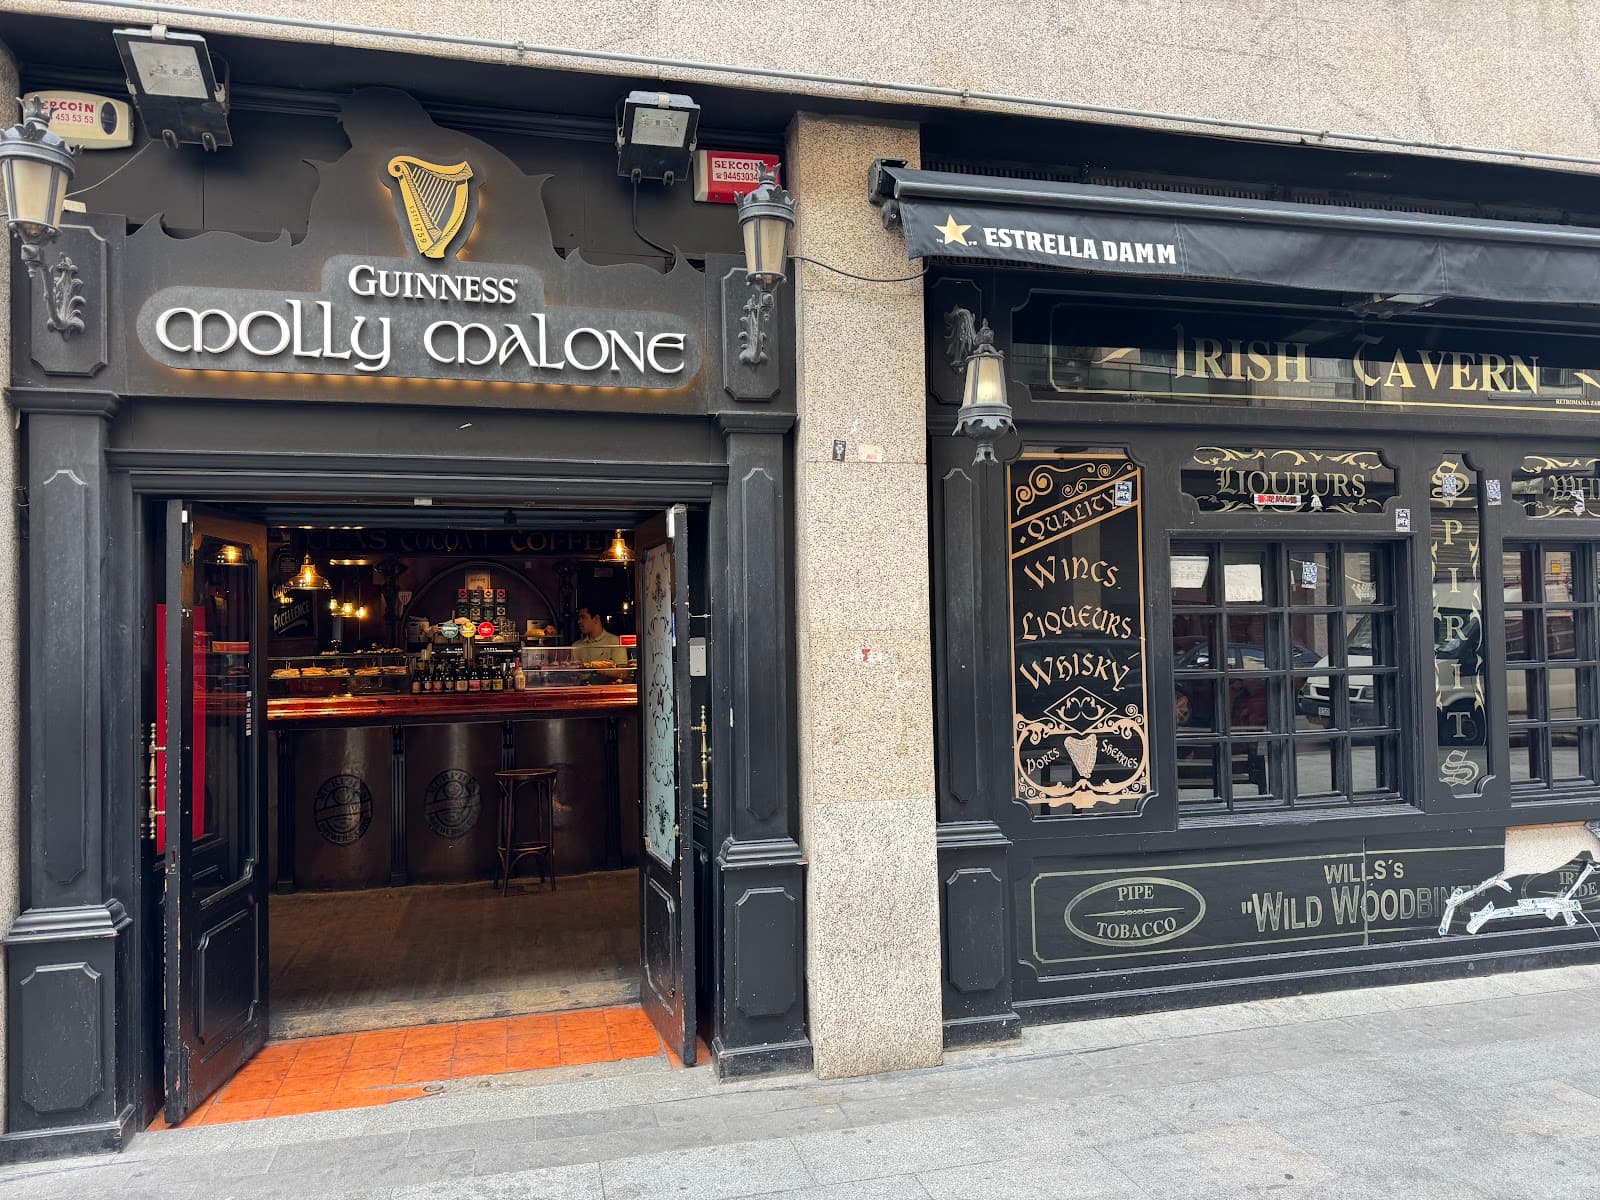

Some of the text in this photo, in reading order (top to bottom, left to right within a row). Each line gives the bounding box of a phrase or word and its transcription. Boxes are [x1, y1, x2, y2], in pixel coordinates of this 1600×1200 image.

[40, 101, 94, 113] ERCOiN
[56, 113, 94, 124] 453 53 53
[723, 171, 759, 182] 94453034
[982, 227, 1177, 265] ESTRELLA DAMM
[348, 264, 517, 304] GUINNESS
[155, 298, 687, 375] MOLLY MALONE
[1174, 321, 1310, 384] IRISH
[1213, 466, 1366, 499] LIQUEURS
[1027, 490, 1118, 540] QUALITY
[1022, 605, 1132, 640] LIQUEURS
[1019, 653, 1131, 692] WHISKY
[1026, 740, 1139, 774] PORTS SHERRIES
[1117, 885, 1155, 902] PIPE
[1097, 917, 1177, 939] TOBACCO
